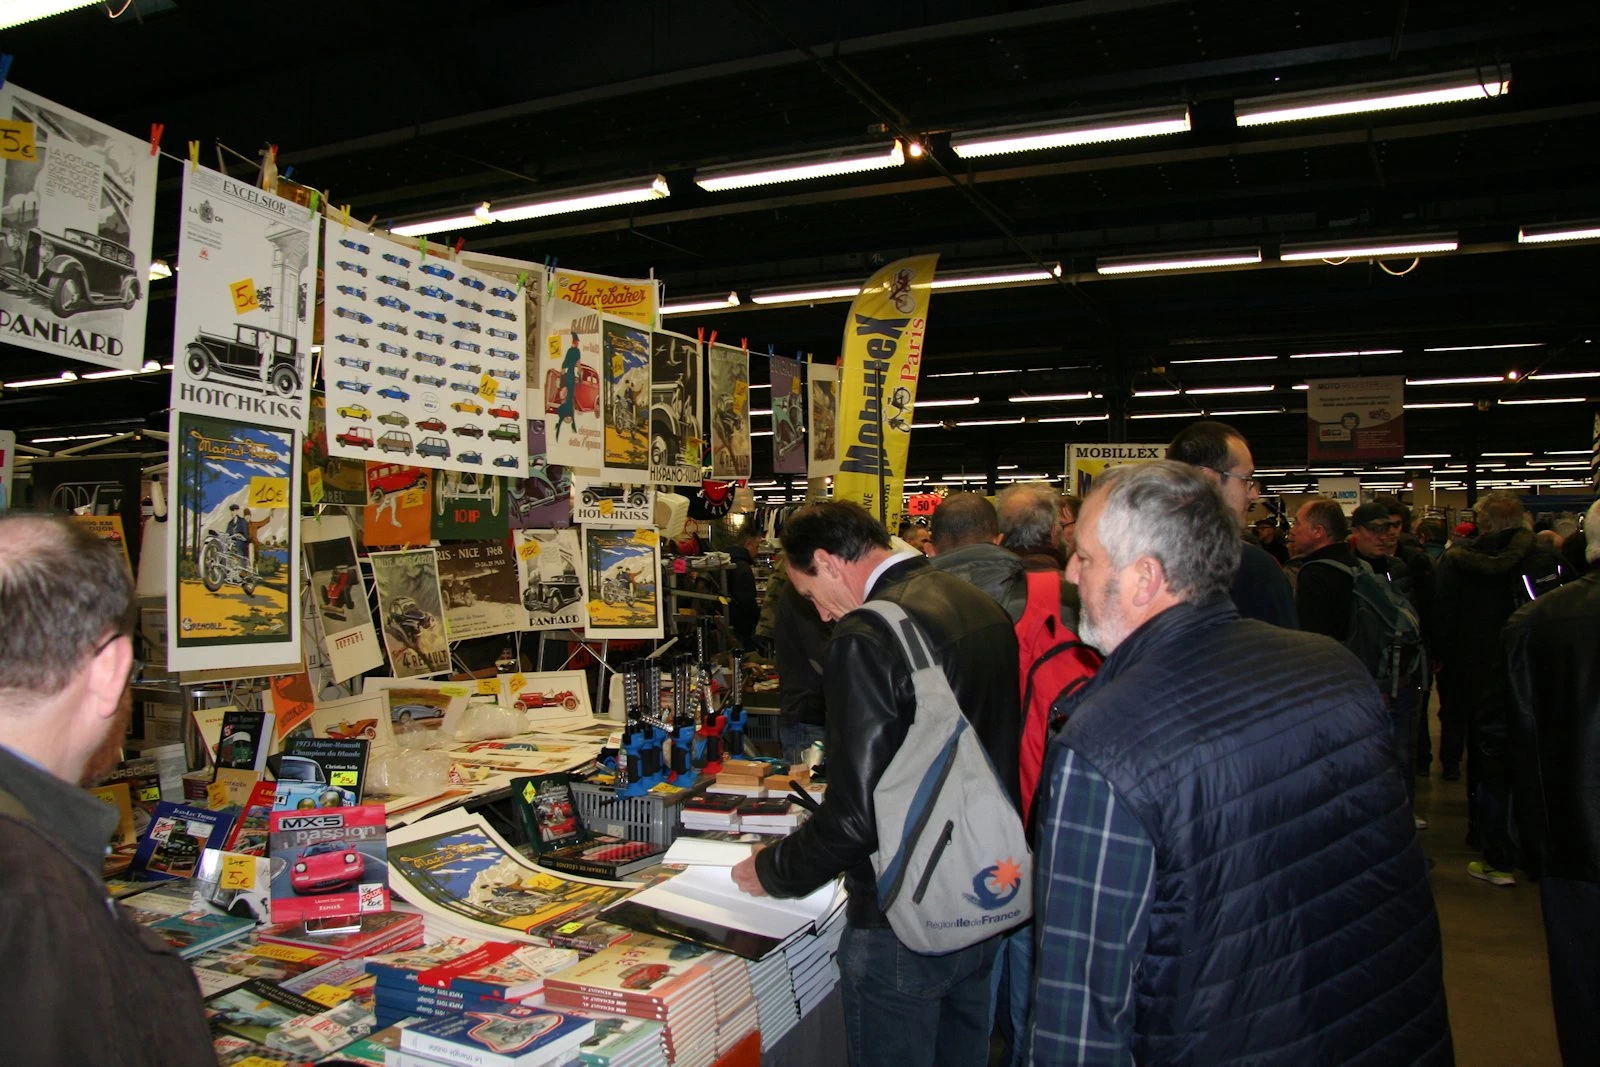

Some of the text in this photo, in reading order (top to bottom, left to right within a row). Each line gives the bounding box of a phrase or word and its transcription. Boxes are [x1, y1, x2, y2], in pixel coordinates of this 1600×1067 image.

[223, 180, 287, 214] EXCELSIOR
[562, 279, 646, 307] Studebaker
[0, 309, 123, 356] PANHARD
[901, 318, 924, 382] Paris
[180, 383, 303, 420] HOTCHKISS
[1076, 447, 1159, 459] MOBILLEX
[255, 482, 284, 504] 10€
[458, 547, 480, 559] NICE
[486, 545, 504, 557] 1968
[530, 614, 580, 626] PANHARD
[283, 817, 341, 829] MX-5
[296, 824, 377, 843] passion
